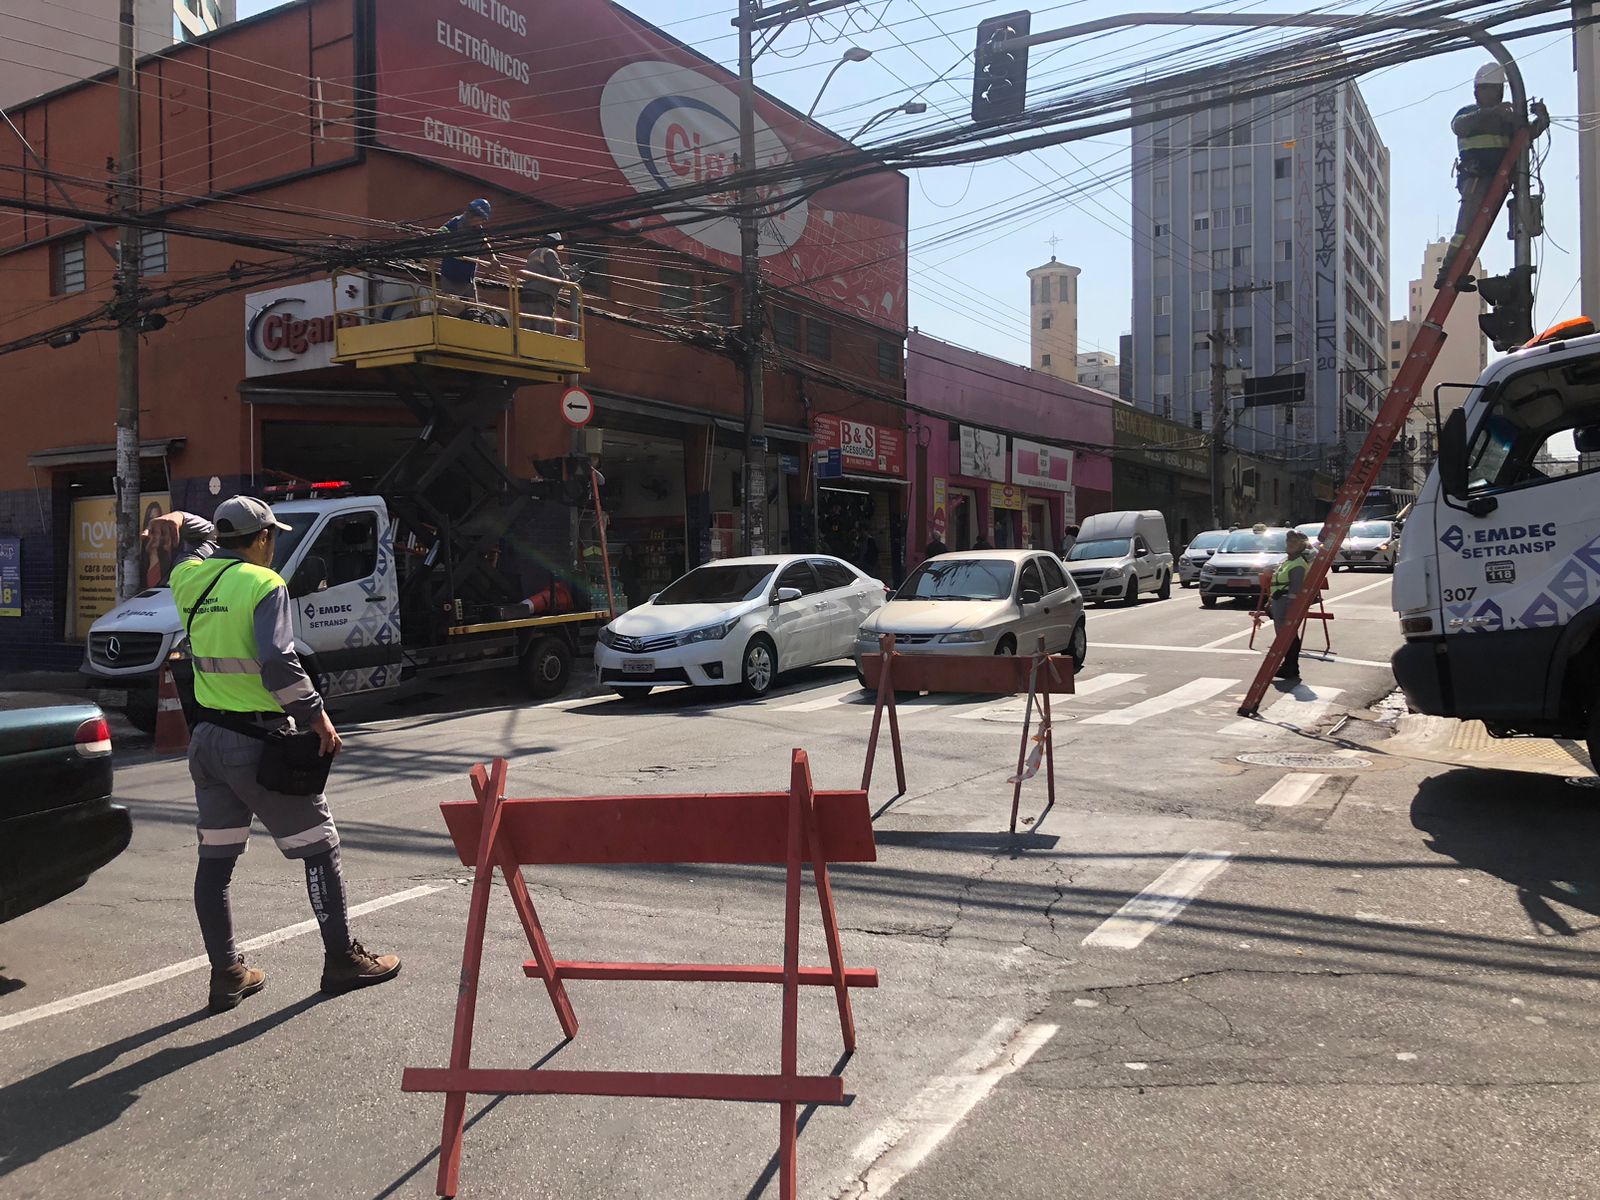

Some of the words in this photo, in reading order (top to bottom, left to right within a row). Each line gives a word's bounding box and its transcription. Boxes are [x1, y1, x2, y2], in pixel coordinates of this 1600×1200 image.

[437, 19, 530, 85] ELETRÔNICOS
[458, 79, 511, 122] MÓVEIS
[423, 116, 482, 160] CENTRO
[484, 140, 540, 181] TÉCNICO
[841, 422, 852, 444] B
[854, 428, 862, 444] &
[865, 427, 874, 448] S
[1474, 522, 1557, 543] EMDEC
[1461, 540, 1556, 559] SETRANSP
[84, 564, 101, 573] cara
[102, 564, 116, 573] nov
[1489, 570, 1512, 580] 118
[1443, 586, 1478, 603] 307
[319, 604, 353, 615] EMDEC
[309, 618, 348, 629] SETRANSP
[308, 866, 324, 910] EMDEC
